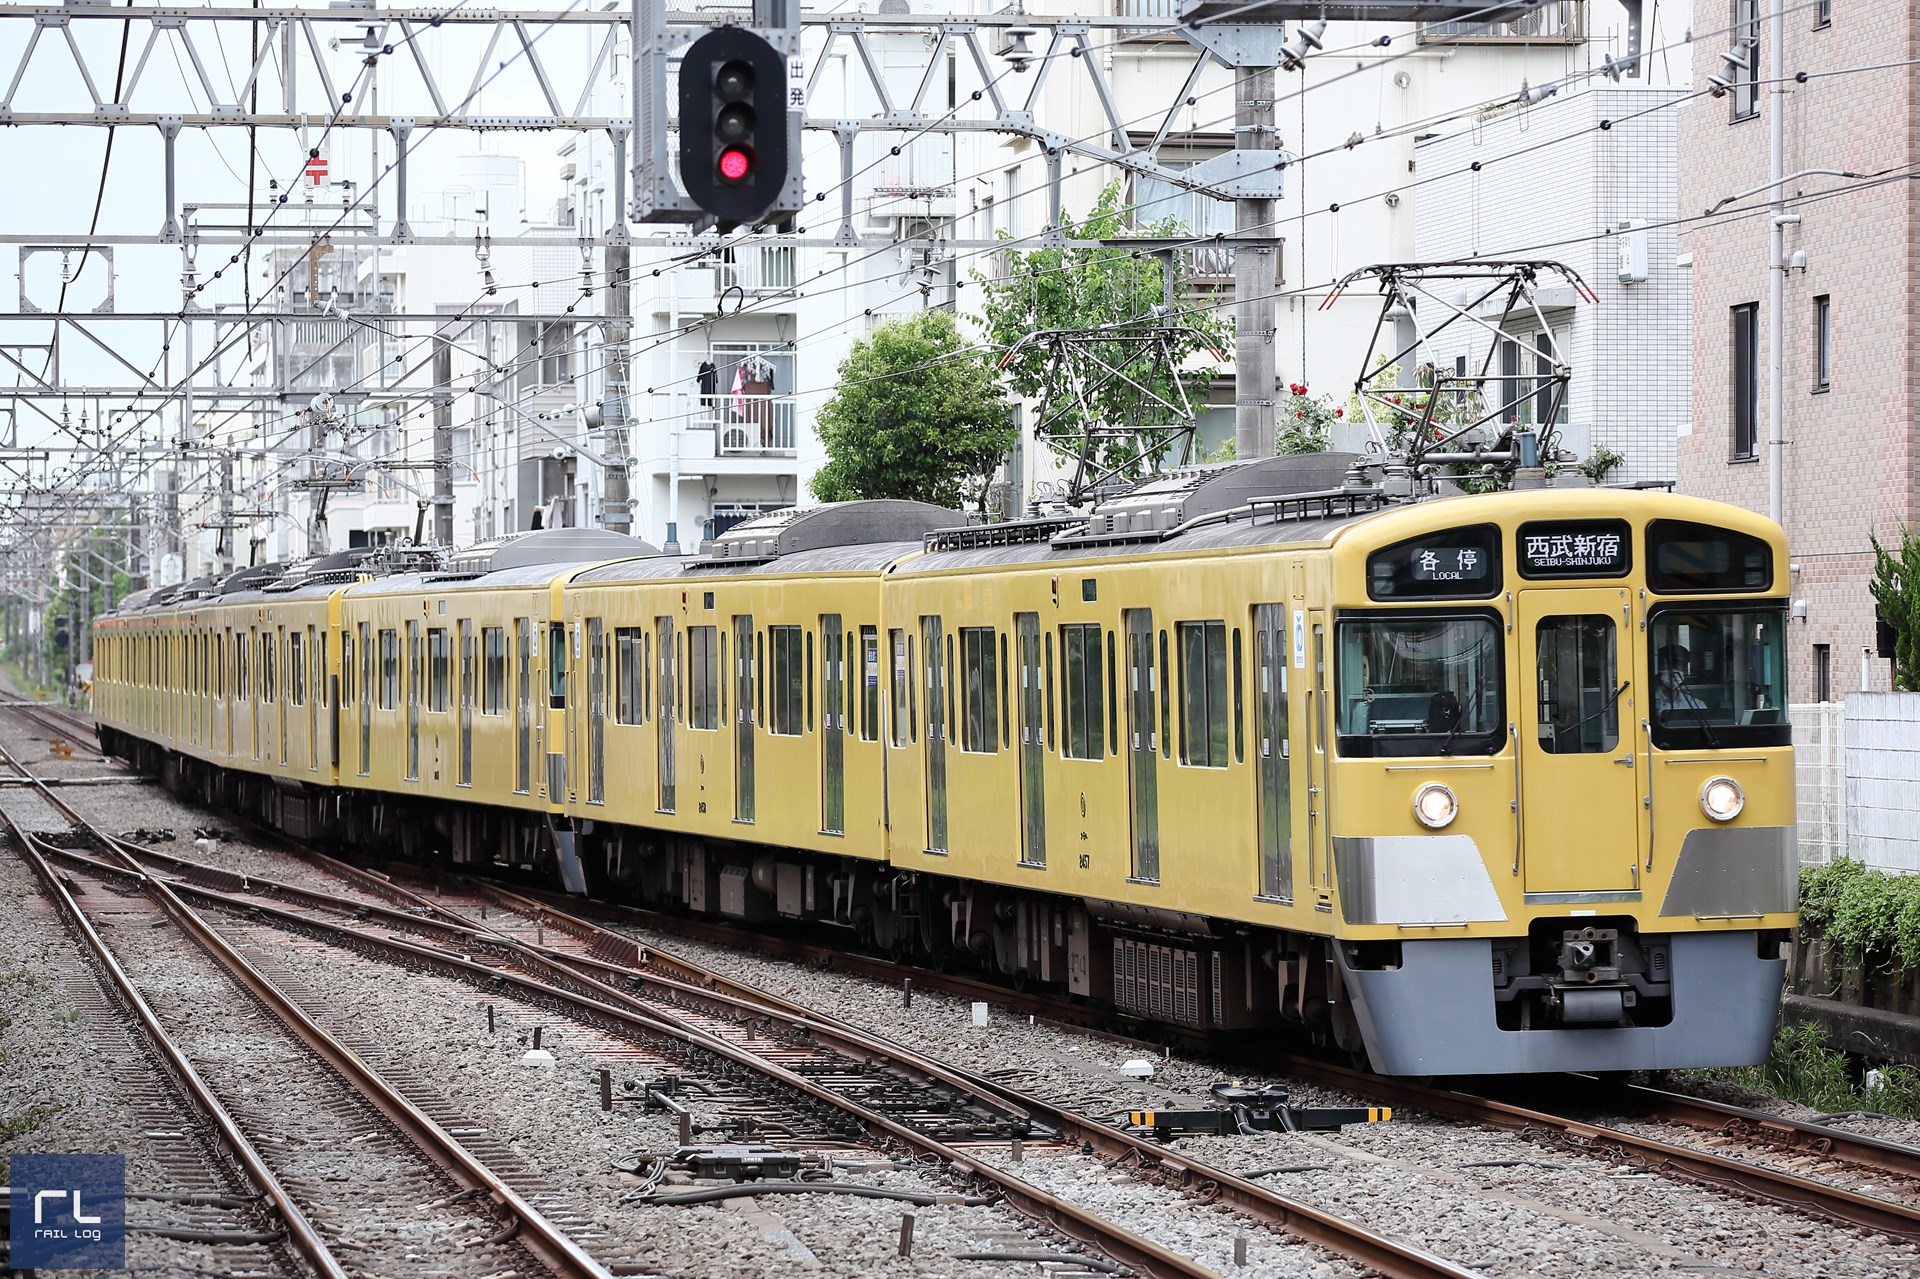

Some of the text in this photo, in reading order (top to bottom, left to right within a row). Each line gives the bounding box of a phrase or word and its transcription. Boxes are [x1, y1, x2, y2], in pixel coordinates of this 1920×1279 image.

[790, 60, 804, 106] 出発
[1525, 534, 1620, 558] 西武新宿
[1534, 557, 1612, 567] SEIBU-SHINJUKU
[1432, 571, 1464, 580] LOCAL
